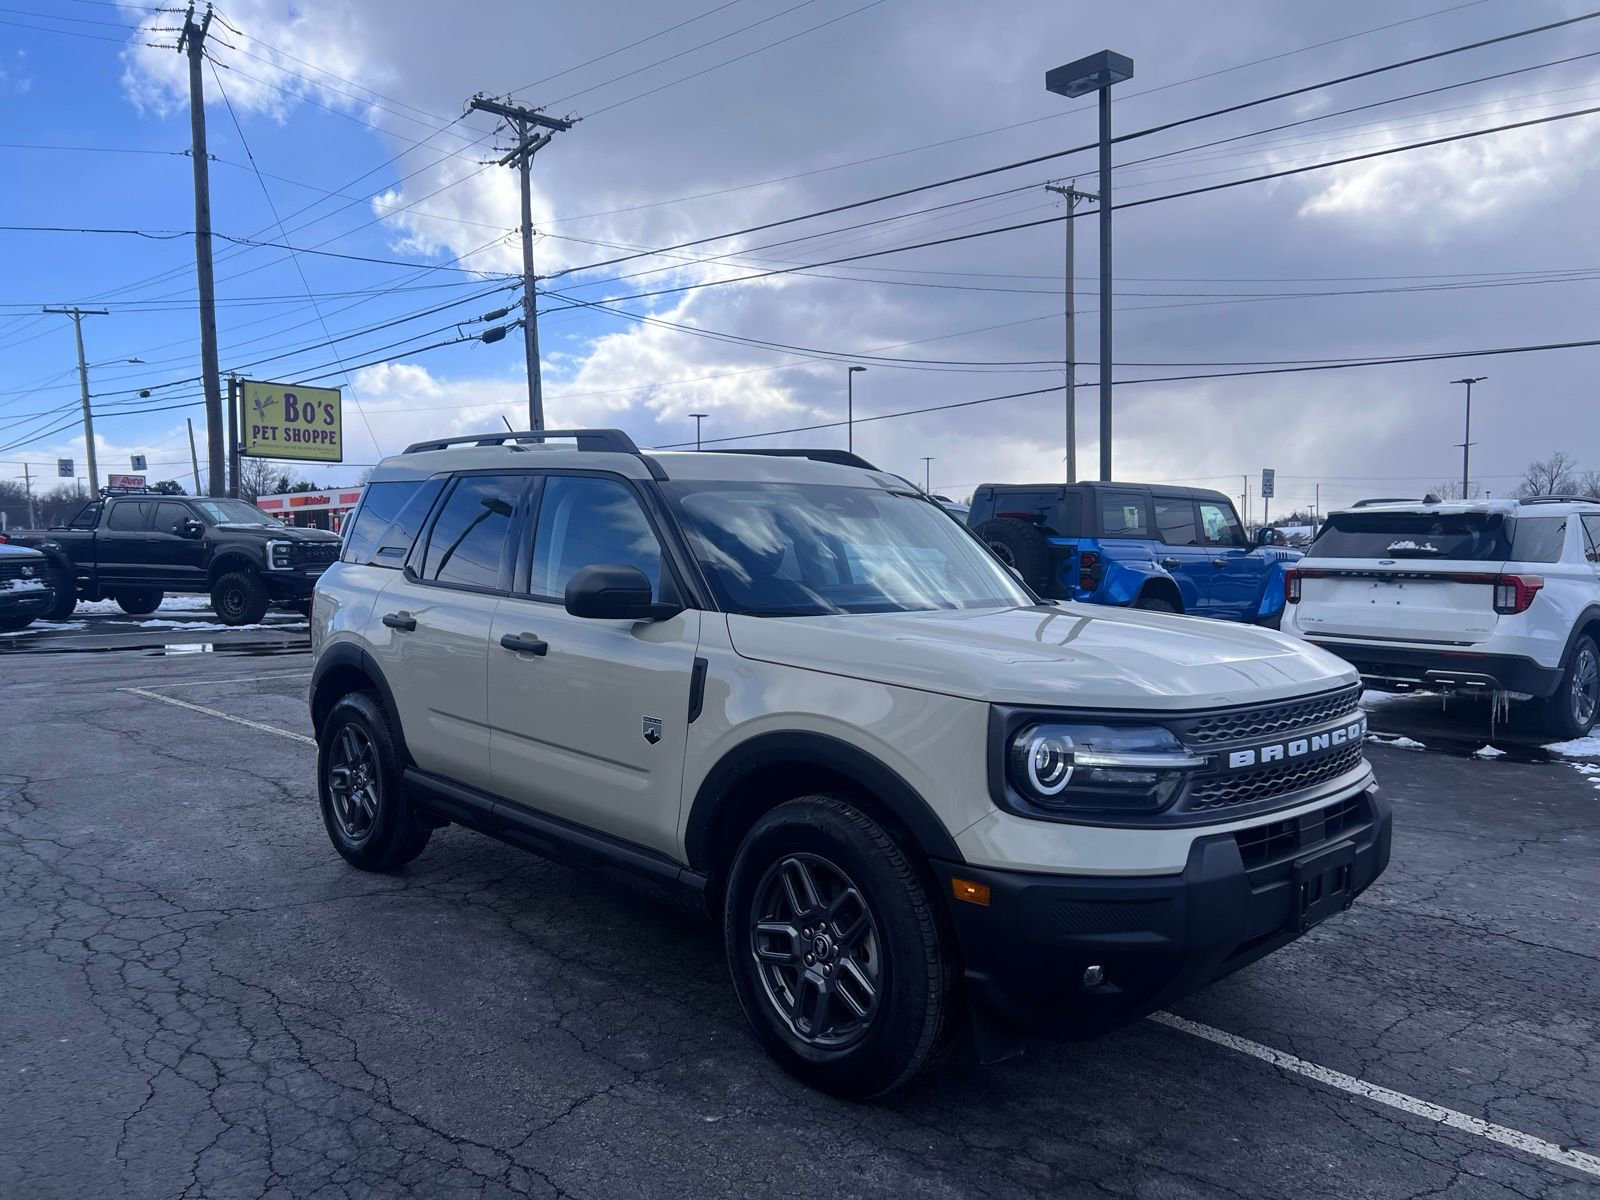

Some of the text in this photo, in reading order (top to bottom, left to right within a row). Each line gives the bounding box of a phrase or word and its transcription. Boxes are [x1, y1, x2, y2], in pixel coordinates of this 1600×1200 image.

[252, 425, 337, 445] PET SHOPPE
[1263, 483, 1273, 494] 25
[1229, 723, 1360, 768] BRONCO
